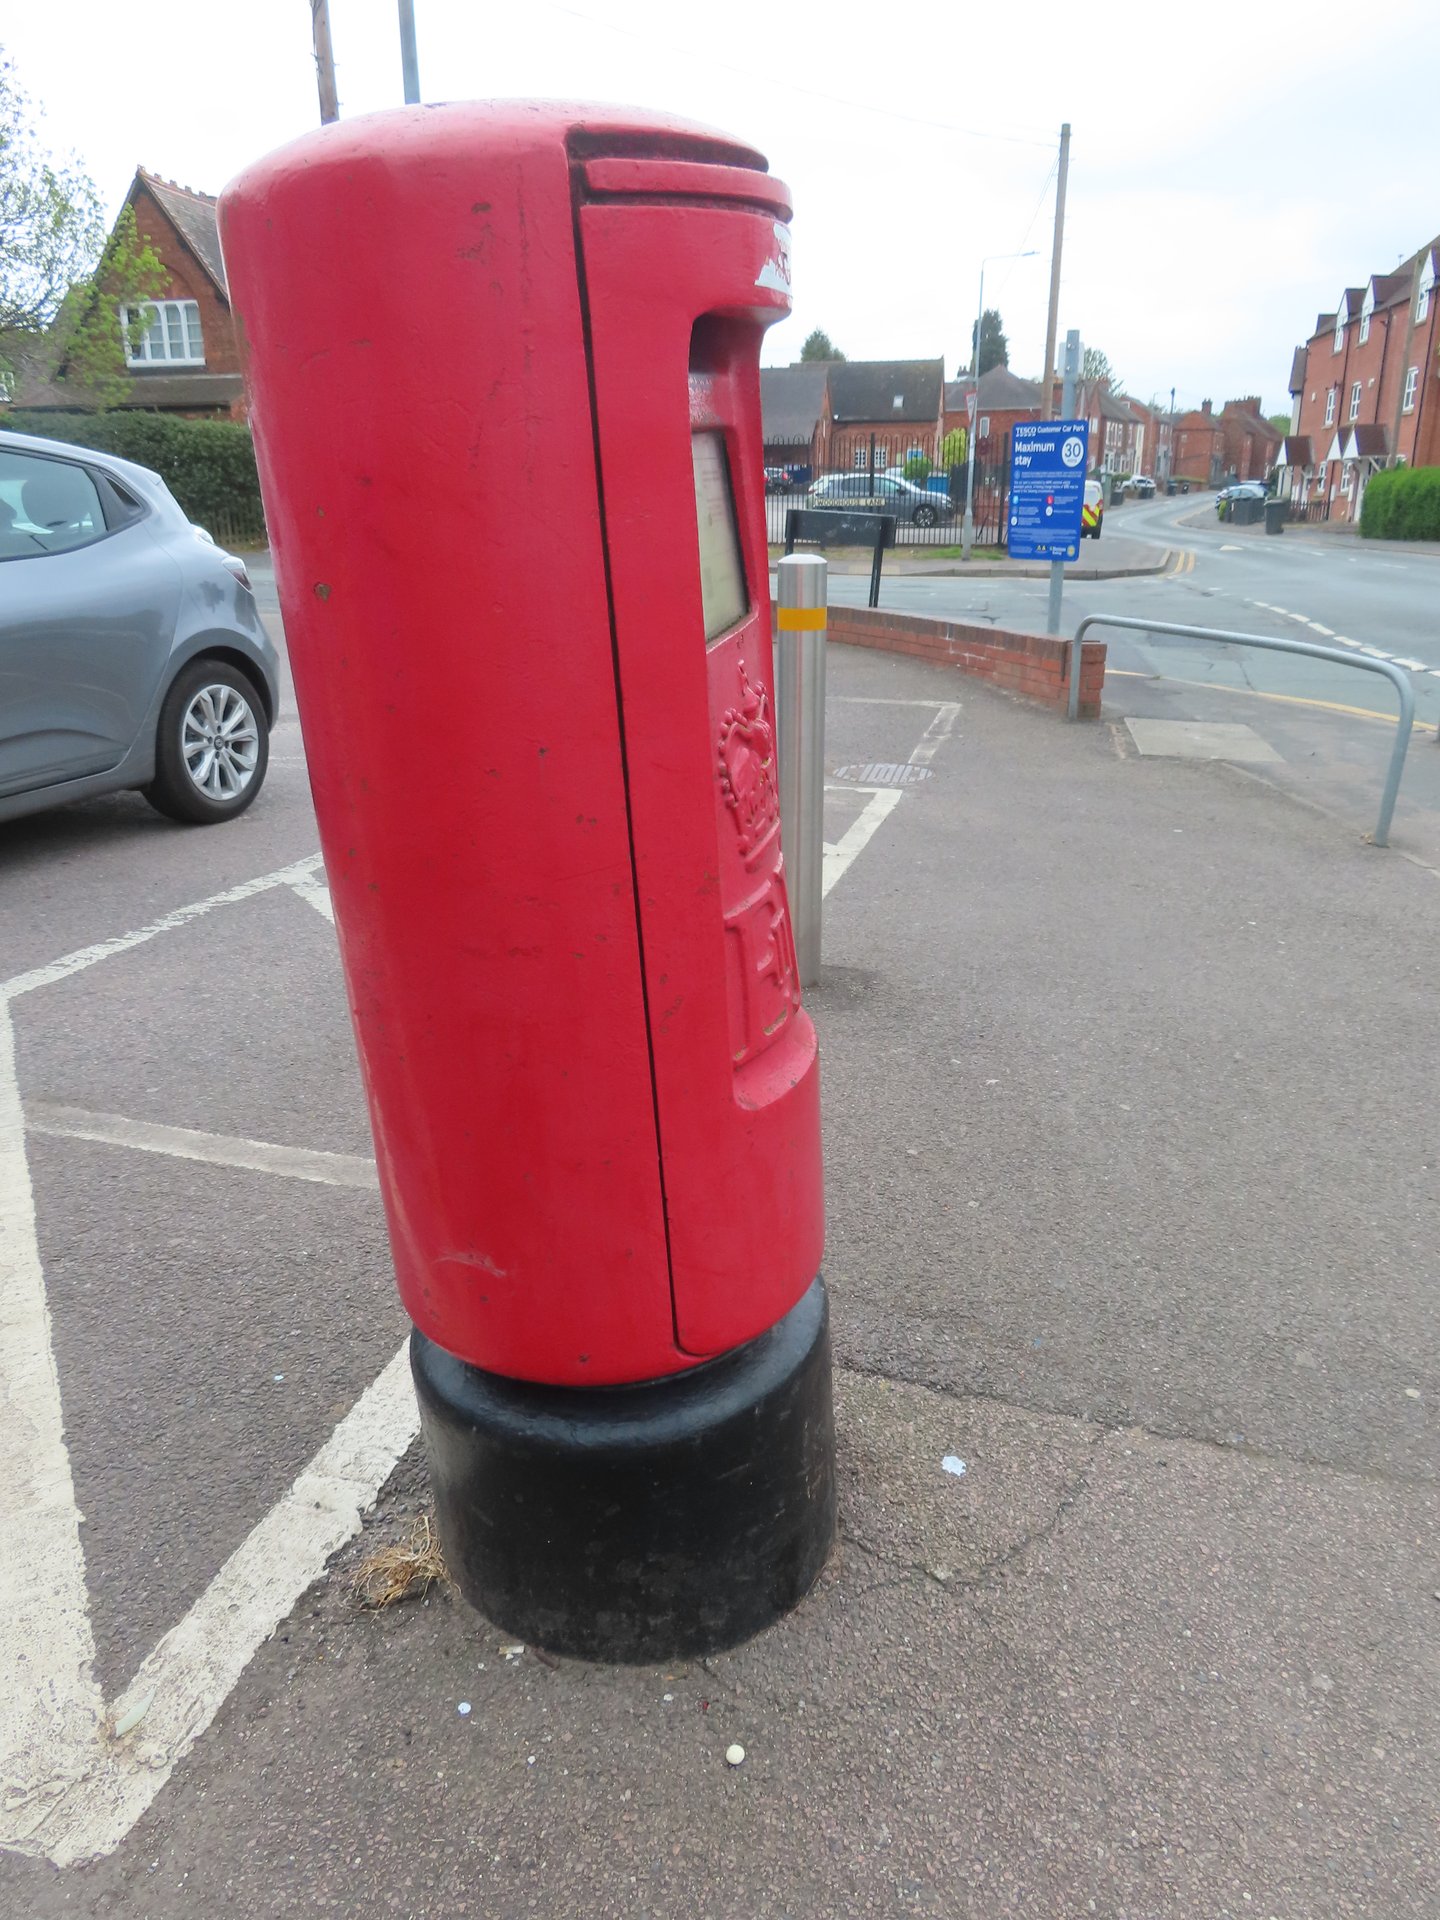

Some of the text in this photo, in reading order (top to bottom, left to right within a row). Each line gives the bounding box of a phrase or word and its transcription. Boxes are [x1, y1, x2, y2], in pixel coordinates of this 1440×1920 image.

[1016, 424, 1085, 435] TESCO Customer Car Park
[1015, 441, 1055, 453] Maximum
[1064, 443, 1081, 457] 30
[1014, 455, 1032, 468] stay
